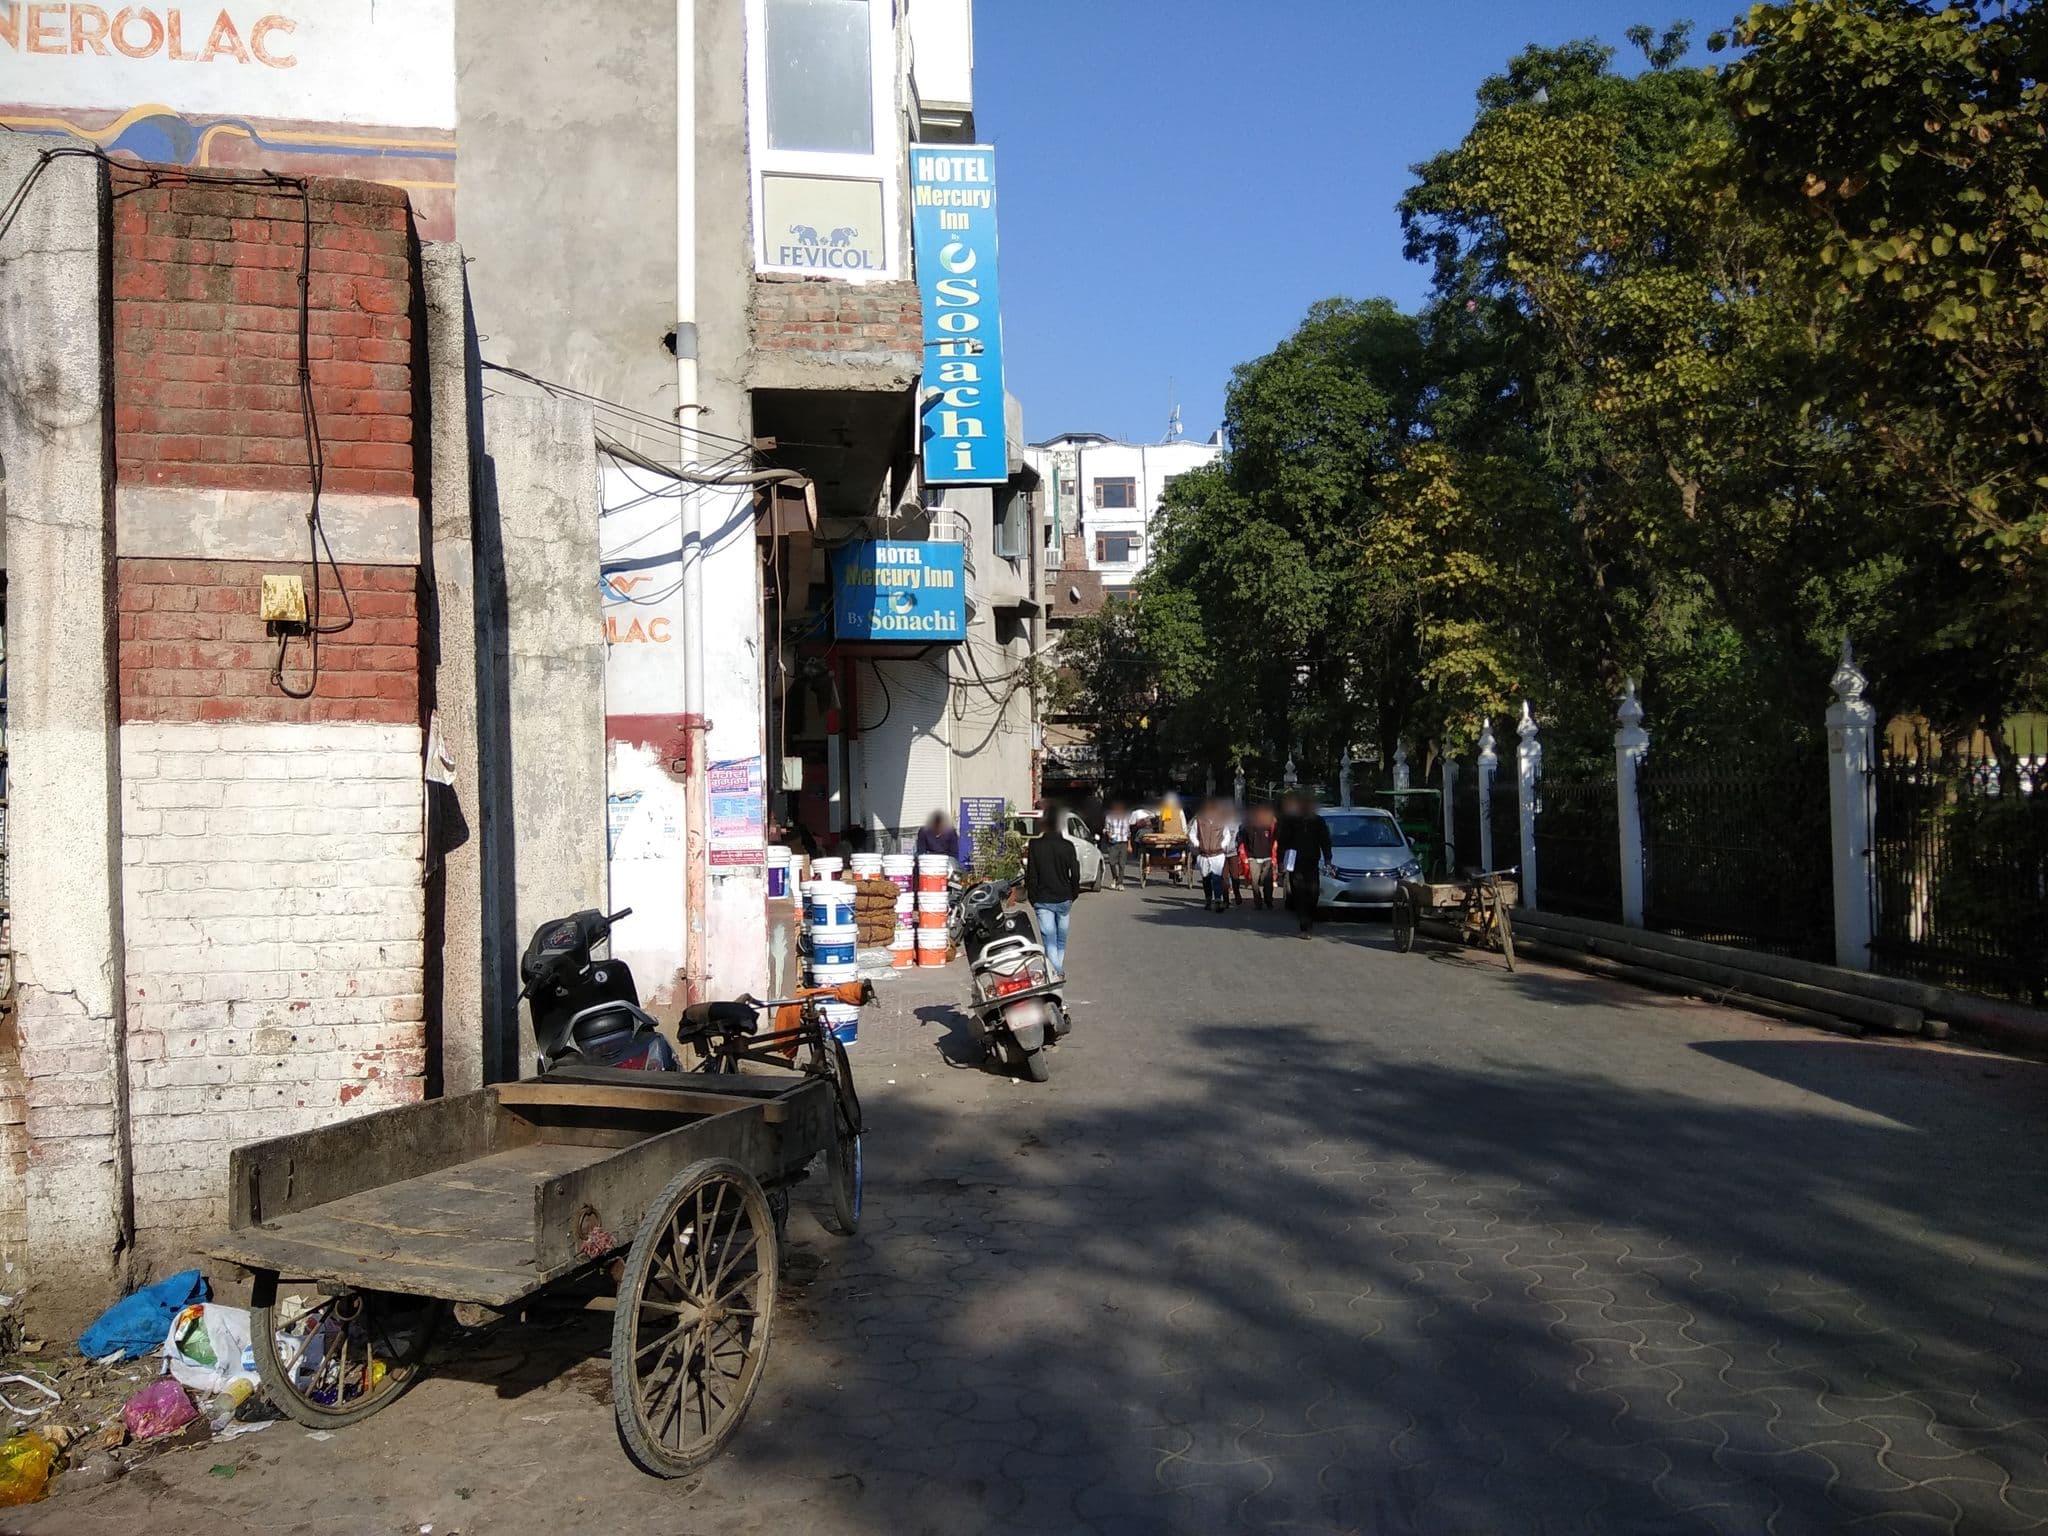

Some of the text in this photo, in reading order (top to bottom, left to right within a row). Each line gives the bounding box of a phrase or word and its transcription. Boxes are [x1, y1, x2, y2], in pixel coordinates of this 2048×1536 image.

[918, 157, 988, 183] HOTEL
[916, 185, 991, 209] Mercury
[940, 210, 970, 230] Inn
[779, 246, 873, 270] FEVICOL
[936, 278, 987, 472] Sonachi
[876, 547, 922, 564] HOTEL
[846, 566, 954, 589] Mercury Inn
[603, 616, 672, 643] LAC
[848, 609, 956, 631] By Sonachi
